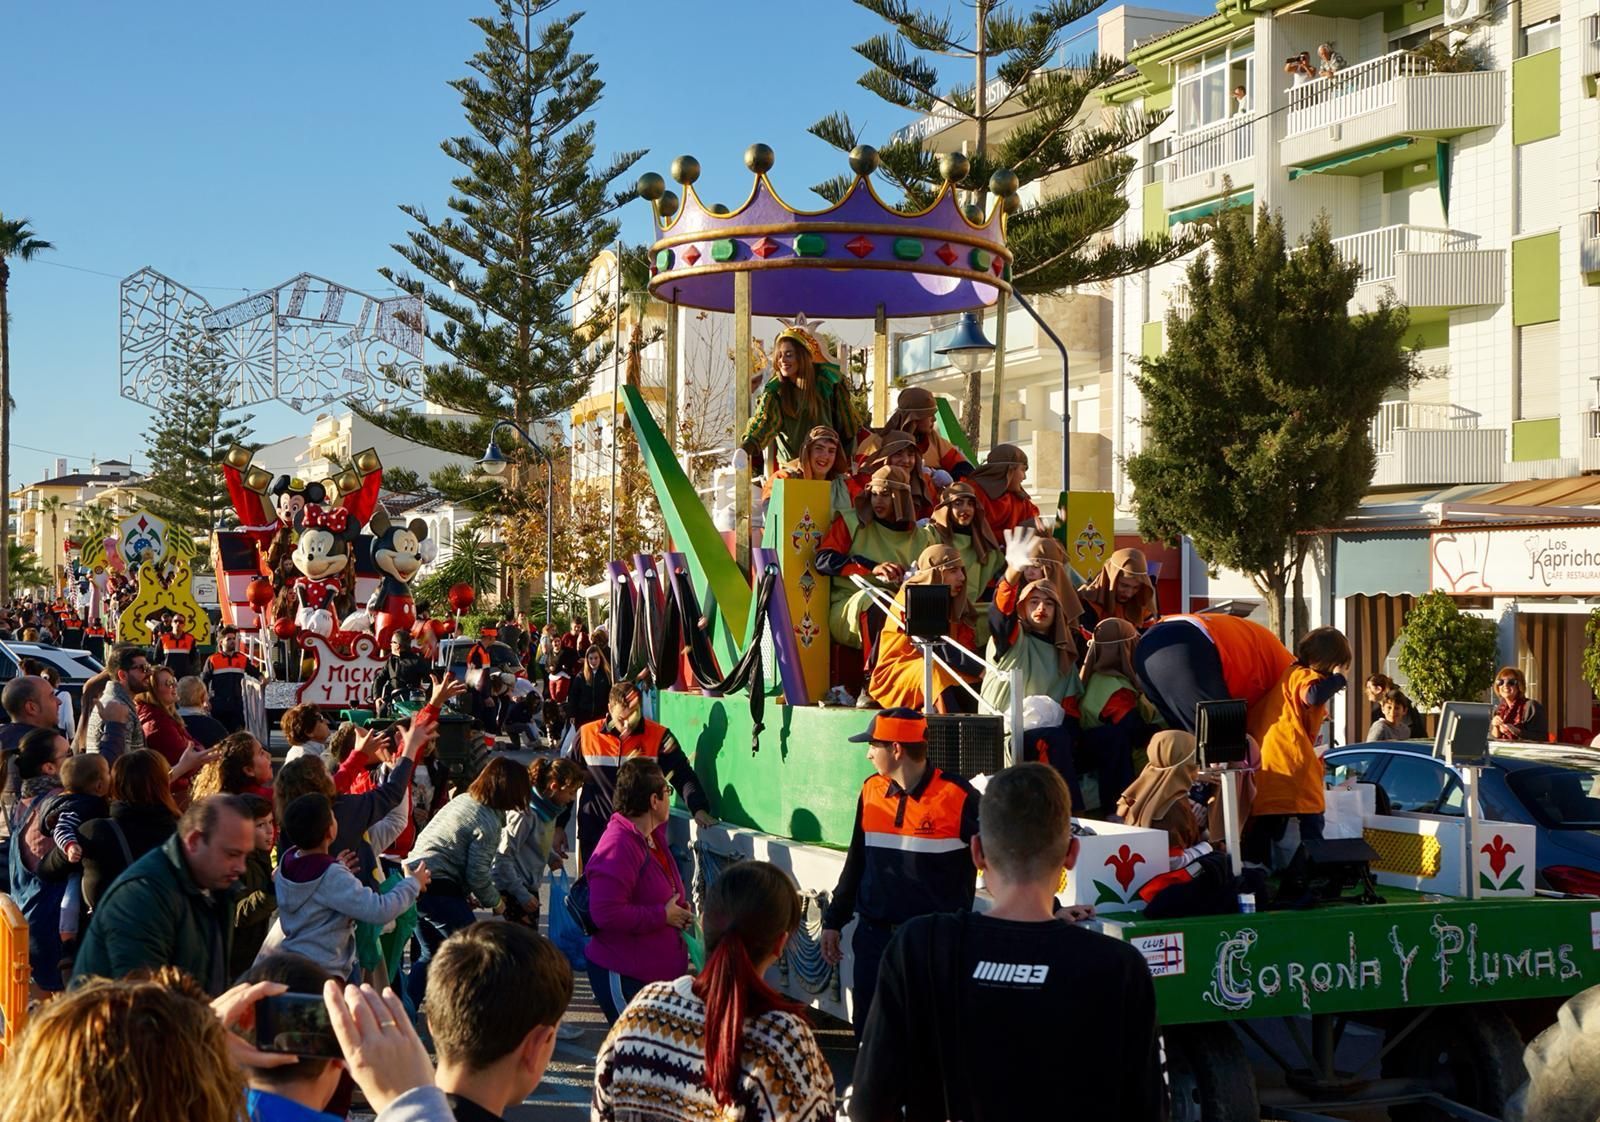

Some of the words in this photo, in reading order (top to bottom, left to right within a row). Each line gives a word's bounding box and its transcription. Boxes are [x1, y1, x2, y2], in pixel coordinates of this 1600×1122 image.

[1548, 538, 1567, 550] Los
[1567, 571, 1600, 580] RESTAURA
[321, 684, 332, 701] Y
[1142, 939, 1165, 949] CLUB
[1388, 925, 1419, 1002] Y
